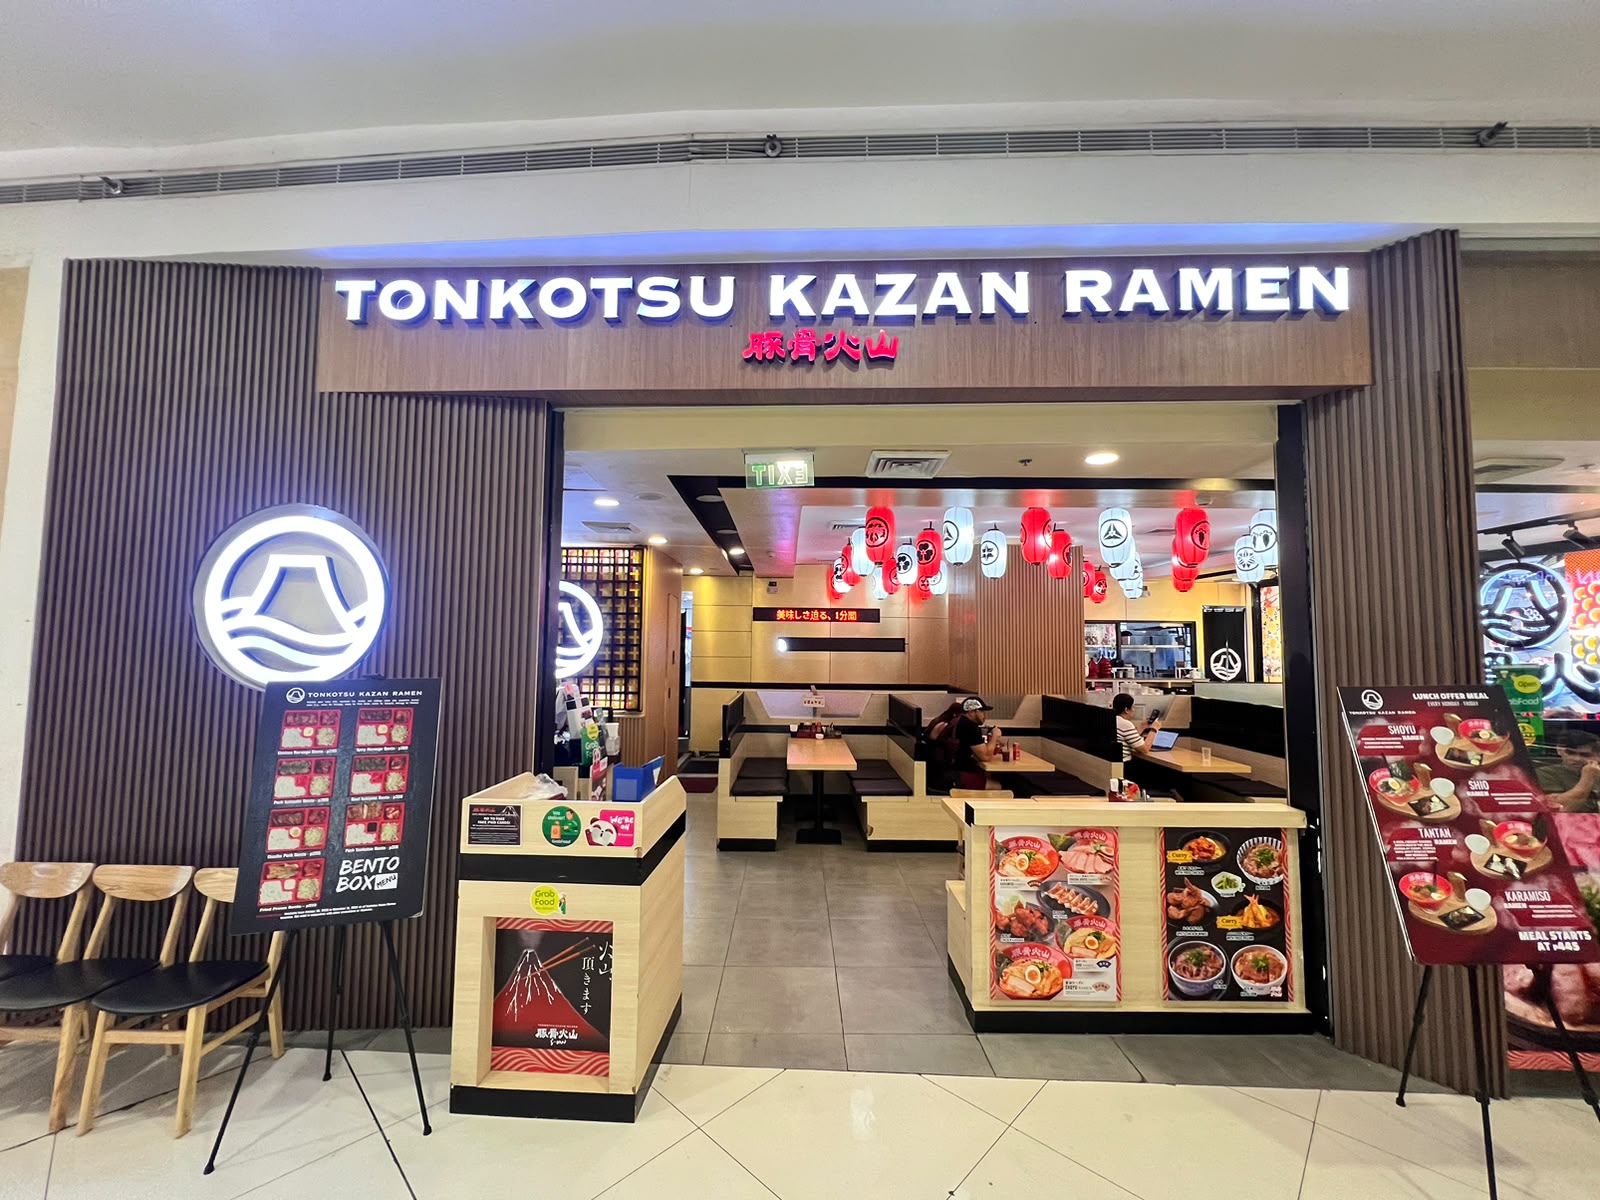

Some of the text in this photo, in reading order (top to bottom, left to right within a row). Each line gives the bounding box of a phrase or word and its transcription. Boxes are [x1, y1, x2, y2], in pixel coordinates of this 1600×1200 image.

[335, 266, 1350, 322] TONKOTSU KAZAN RAMEN
[742, 328, 899, 363] 豚骨火山
[1517, 681, 1538, 689] Open
[1440, 692, 1466, 700] OFFER
[1466, 692, 1490, 700] MEAL
[1387, 725, 1416, 735] SHOYU
[1468, 780, 1490, 790] SHIO
[1418, 828, 1452, 839] TANTAN
[338, 856, 400, 876] BENTO
[335, 874, 397, 893] BOX MENU
[534, 889, 556, 898] Grab
[1504, 890, 1551, 902] KARAMISO
[534, 898, 555, 906] Food
[1518, 931, 1592, 941] MEAL STARTS
[1537, 942, 1551, 952] AT
[580, 956, 595, 1015] 頂きます
[535, 1028, 578, 1040] 豚骨火山
